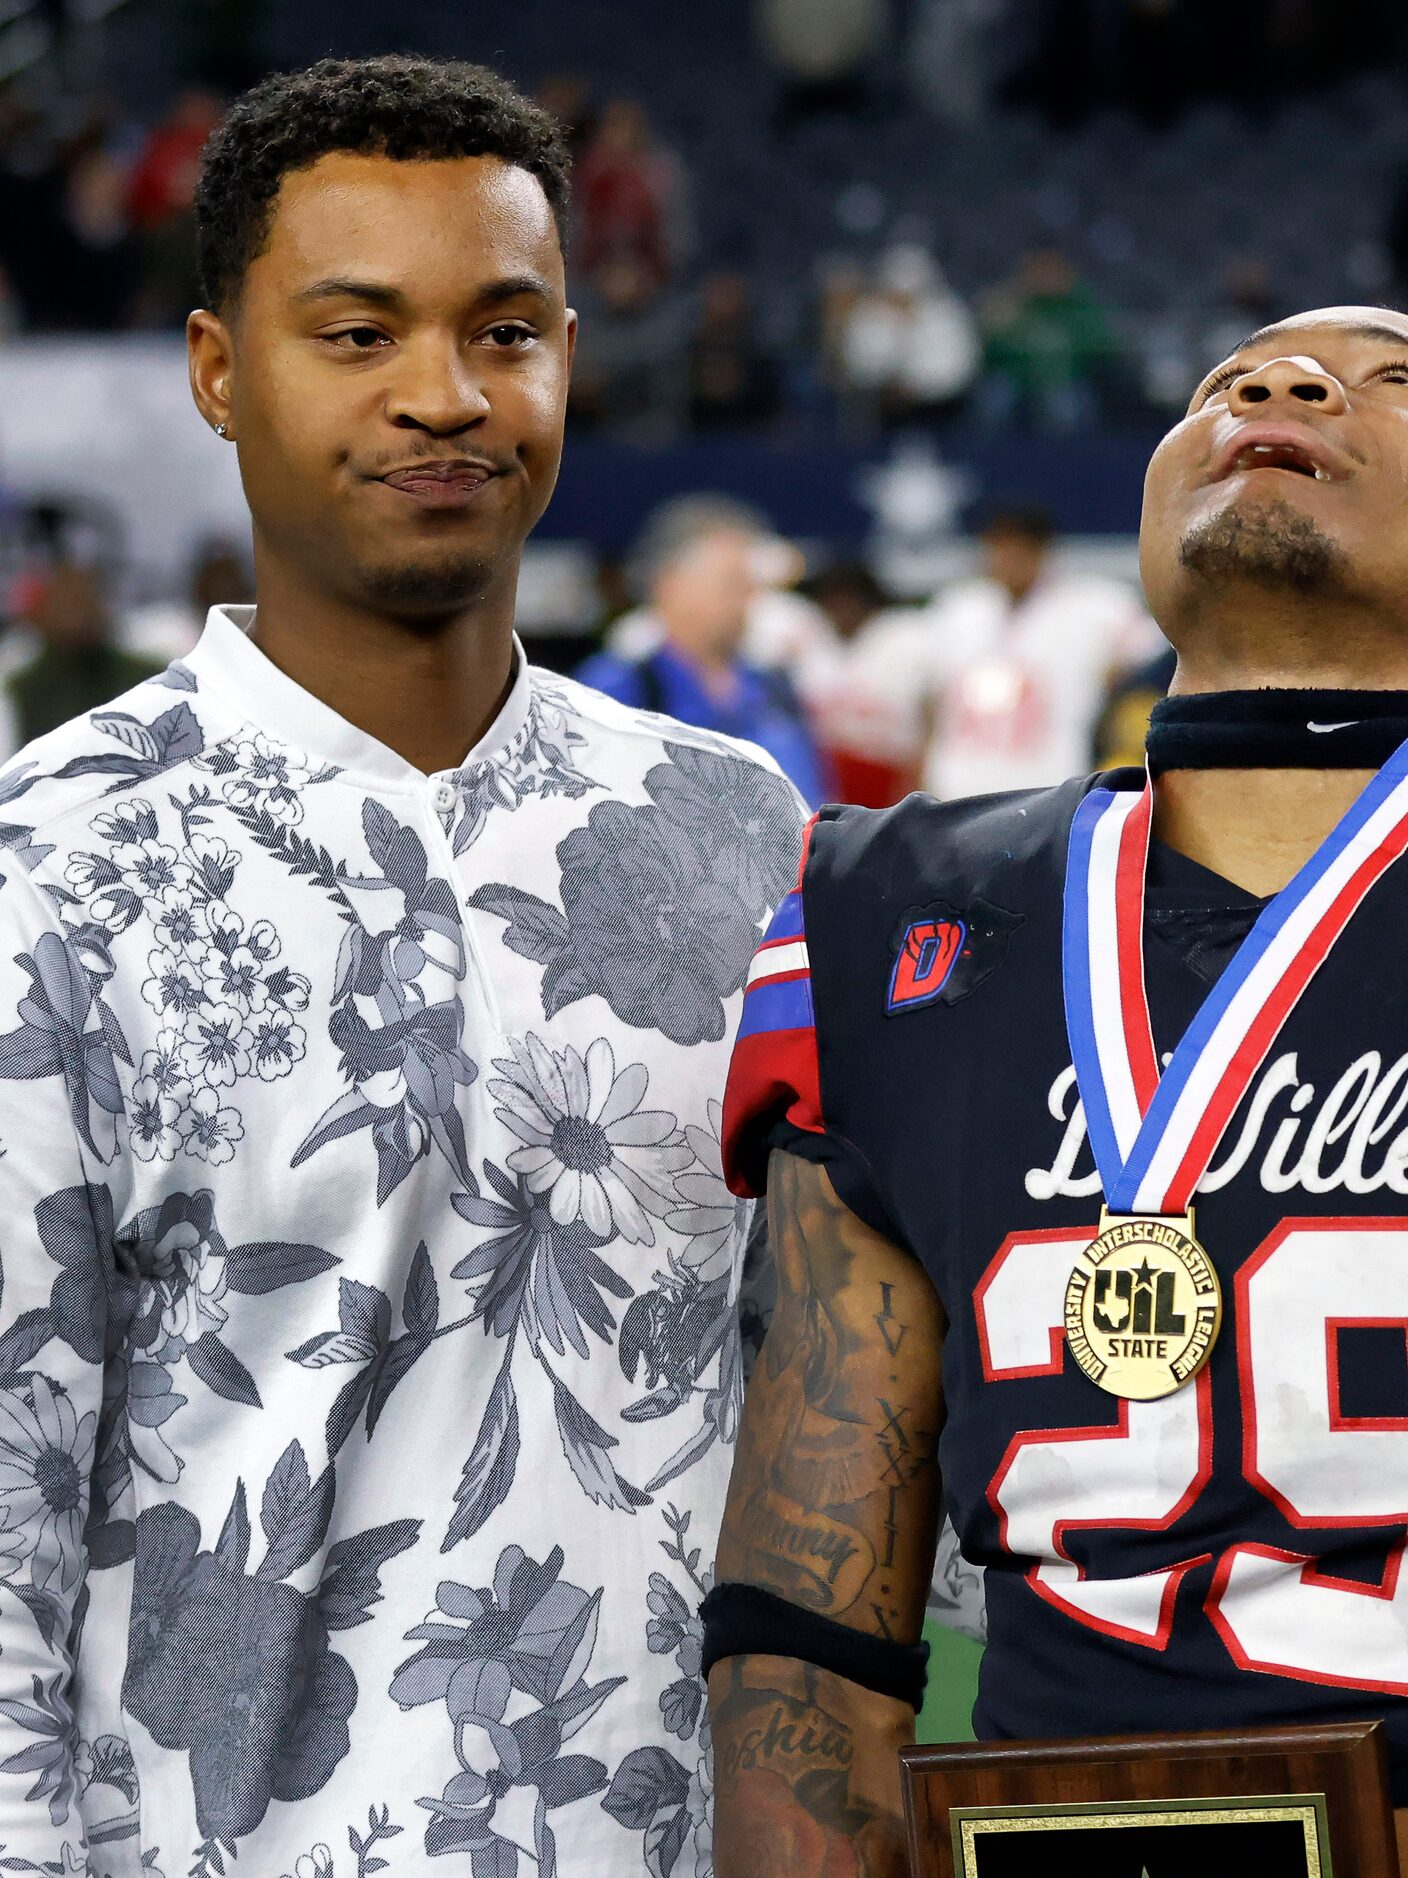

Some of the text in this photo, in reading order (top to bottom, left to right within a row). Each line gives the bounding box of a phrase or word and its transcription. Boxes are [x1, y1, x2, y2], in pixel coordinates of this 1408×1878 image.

[886, 918, 967, 1011] D
[1085, 1223, 1214, 1293] INTERSCHOLASTIC
[1066, 1274, 1105, 1380] UNIVERSITY
[1107, 1338, 1168, 1359] STATE
[1173, 1308, 1216, 1380] LEAGUE
